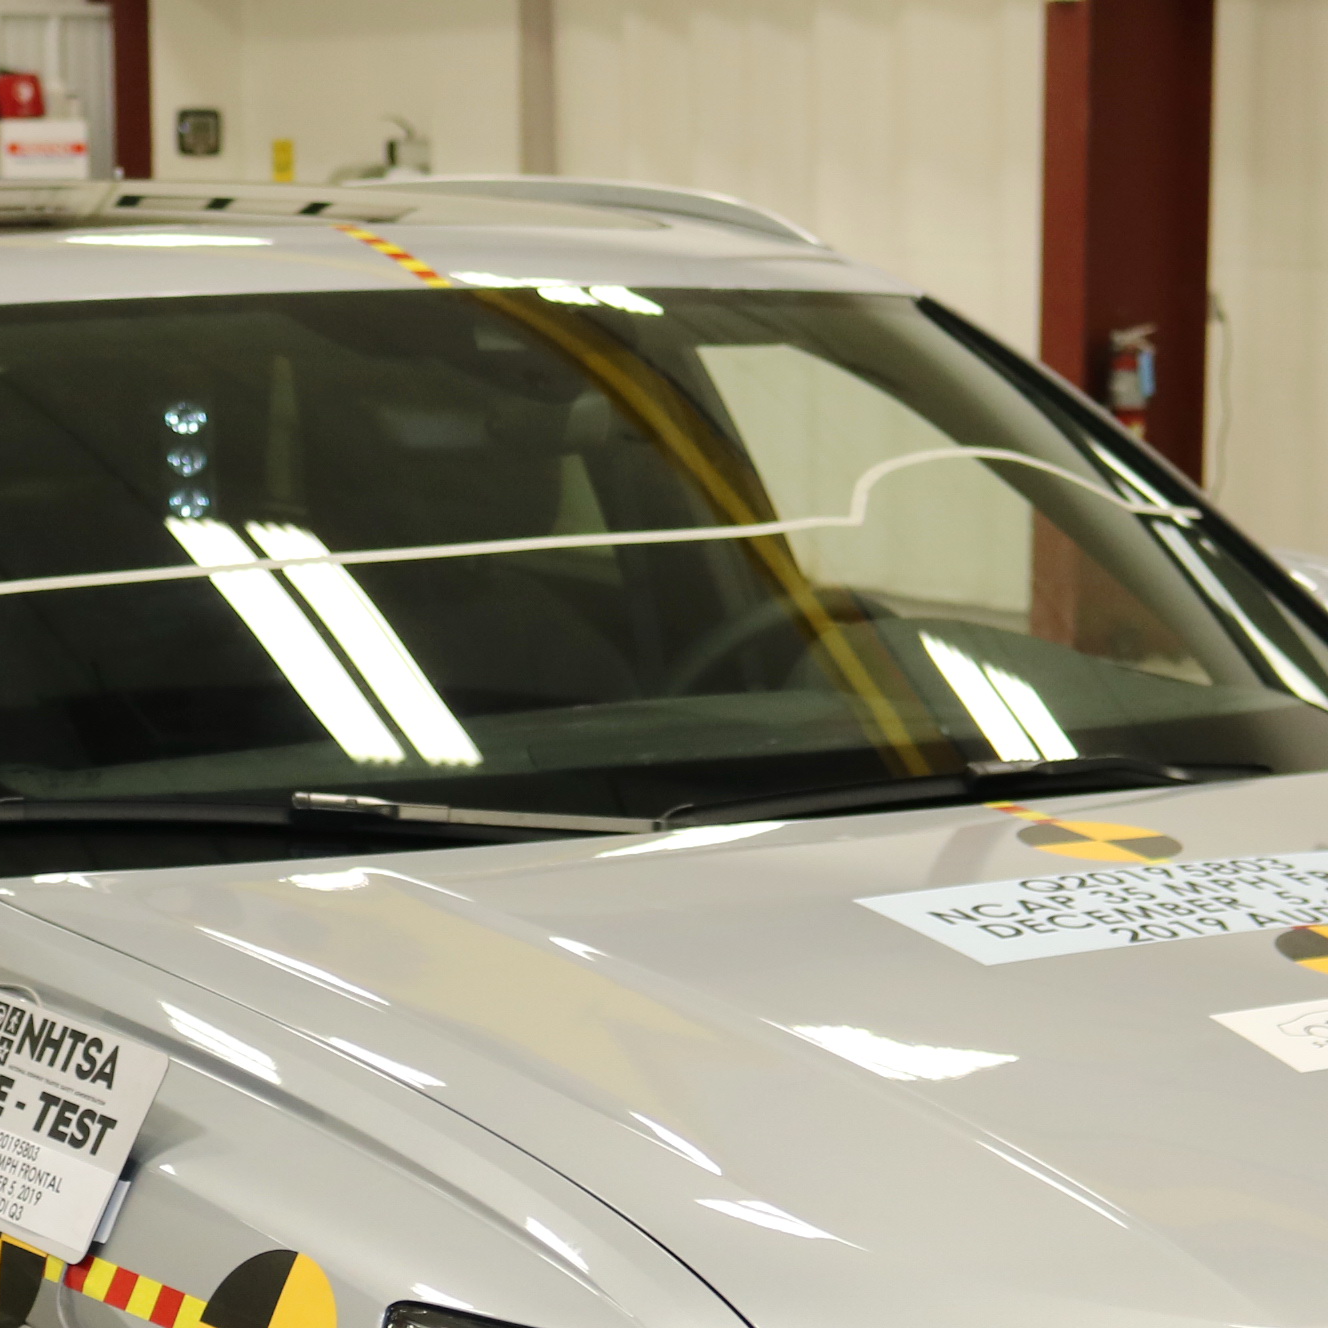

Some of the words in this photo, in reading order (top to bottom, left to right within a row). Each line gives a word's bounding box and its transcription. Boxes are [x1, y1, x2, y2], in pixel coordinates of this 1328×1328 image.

[1018, 857, 1295, 893] Q20195803
[926, 894, 1076, 926] NCAP
[1088, 886, 1157, 904] 35
[1162, 875, 1283, 898] MPH
[976, 895, 1256, 939] DECEMBER
[1109, 916, 1230, 943] 2019
[15, 1013, 121, 1090] NHTSA
[32, 1091, 118, 1156] TEST
[17, 1162, 63, 1194] FRONTAL
[17, 1184, 43, 1206] 2019
[8, 1202, 24, 1221] Q3
